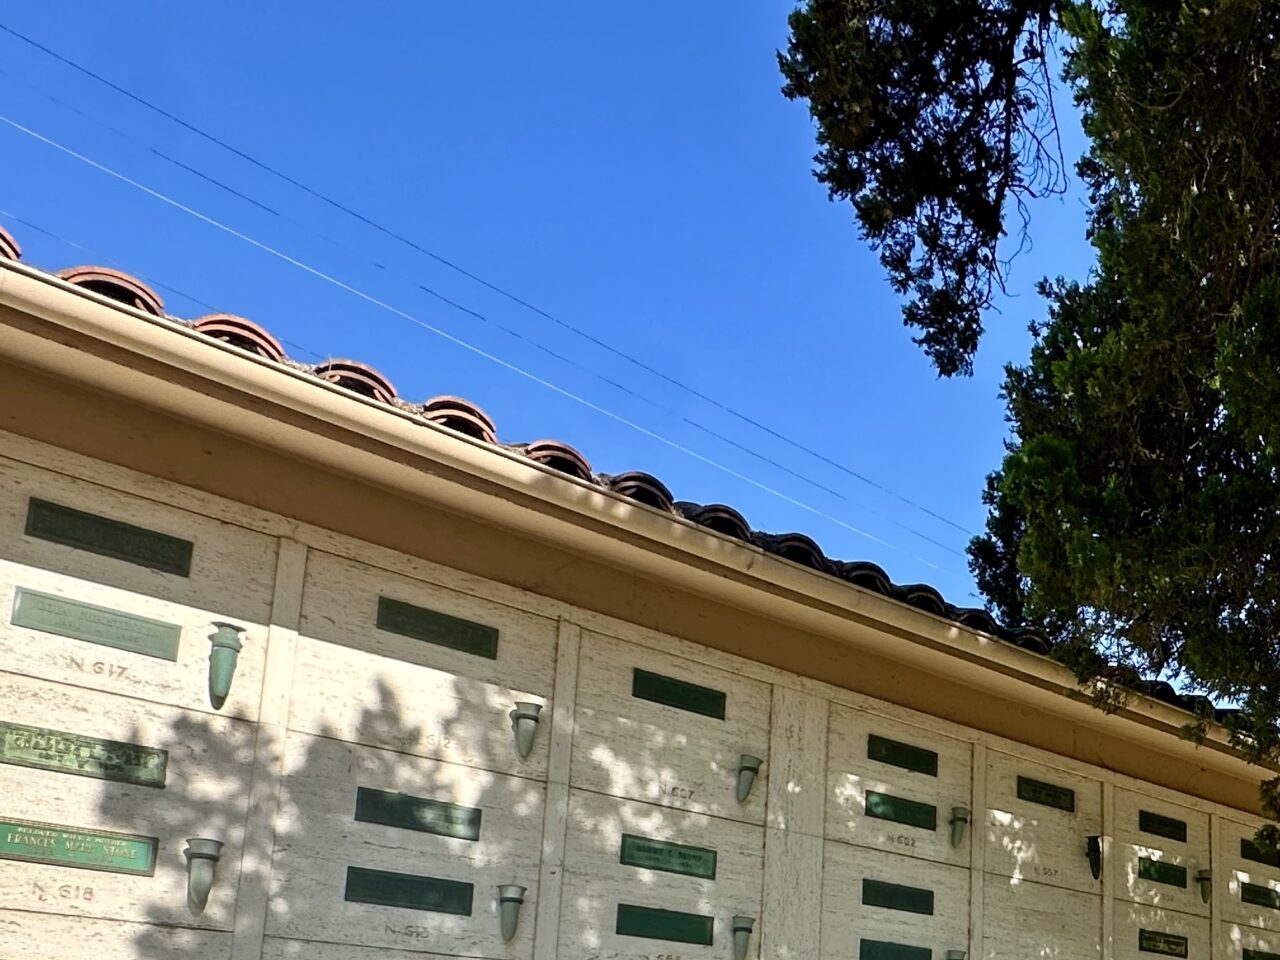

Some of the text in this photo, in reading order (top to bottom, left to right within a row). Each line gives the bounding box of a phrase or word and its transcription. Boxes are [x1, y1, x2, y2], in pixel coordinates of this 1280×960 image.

[71, 656, 127, 675] N 617
[7, 833, 56, 847] FRANCES
[59, 885, 96, 901] 618
